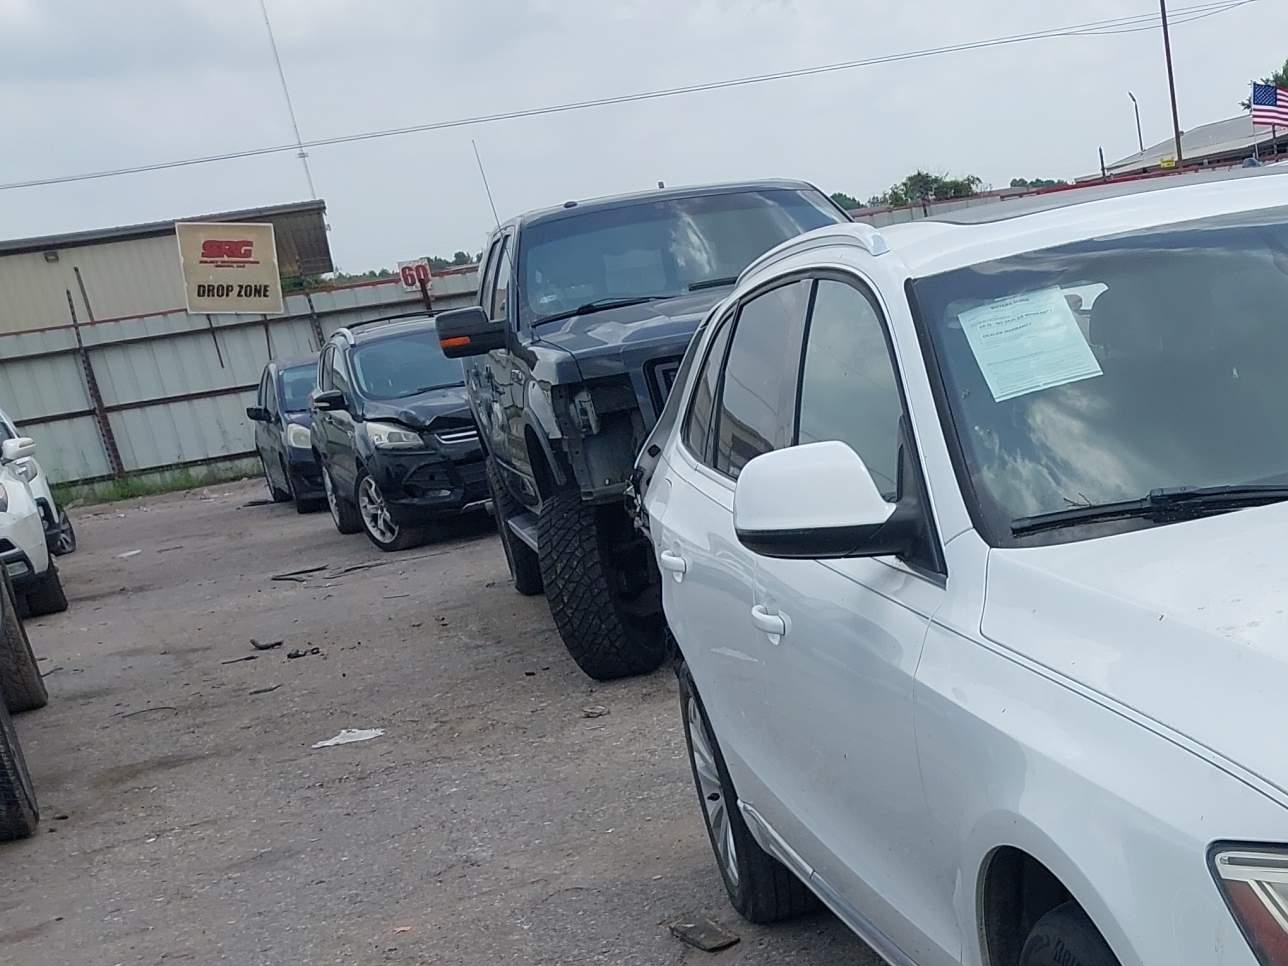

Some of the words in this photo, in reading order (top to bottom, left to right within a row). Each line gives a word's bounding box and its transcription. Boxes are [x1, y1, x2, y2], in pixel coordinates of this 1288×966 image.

[401, 264, 429, 287] 60
[197, 284, 234, 298] DROP
[236, 284, 270, 298] ZONE
